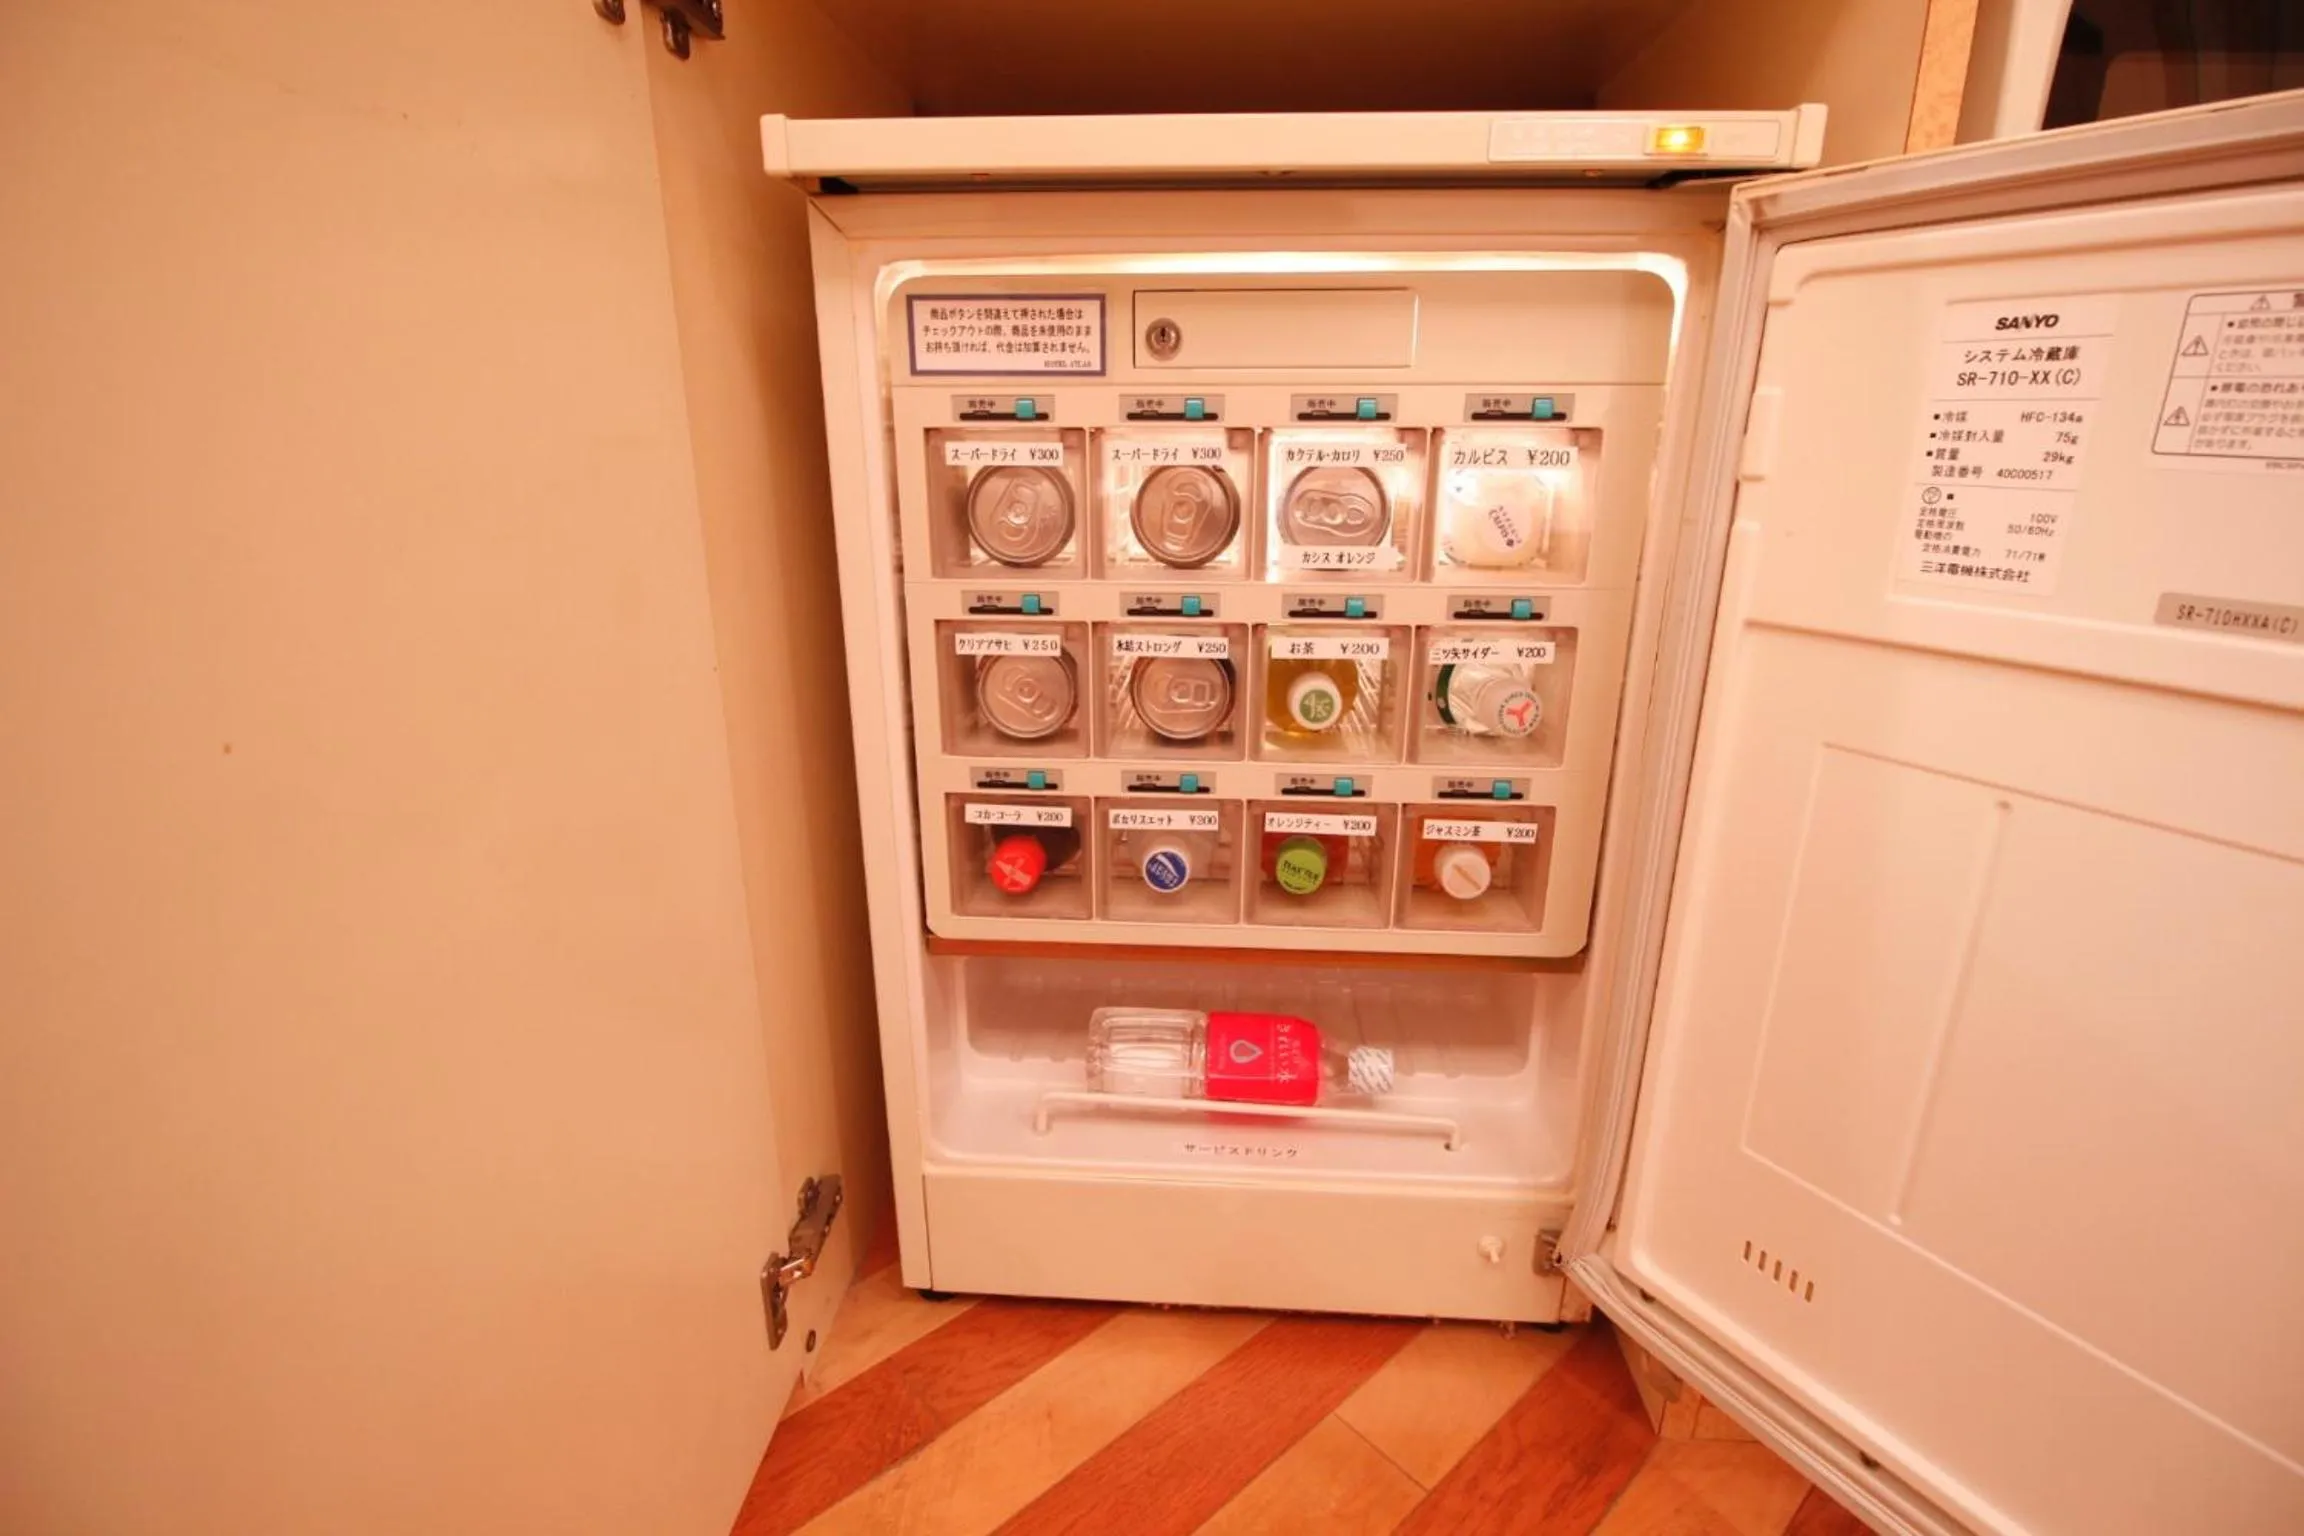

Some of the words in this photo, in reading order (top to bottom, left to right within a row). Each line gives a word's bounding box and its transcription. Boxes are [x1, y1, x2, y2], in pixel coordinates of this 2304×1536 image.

[1995, 314, 2060, 330] SANYO
[1964, 345, 2081, 363] システム冷蔵庫
[2020, 411, 2084, 424] HFC-134a
[2055, 431, 2079, 445] 75g
[951, 448, 1017, 461] スーパードライ
[1029, 448, 1060, 461] ¥300
[1112, 447, 1179, 461] スーパードライ
[1191, 447, 1222, 460] ¥300
[1373, 449, 1405, 462] ¥250
[1527, 449, 1571, 466] ¥200
[2042, 451, 2076, 465] 29kg
[1301, 552, 1331, 564] カシス
[1335, 551, 1376, 564] オレンジ
[959, 638, 1013, 651] クリアアサヒ
[1023, 640, 1059, 652] ¥250
[1196, 643, 1227, 654] ¥250
[1289, 641, 1315, 656] お茶
[1339, 642, 1381, 656] ¥200
[1432, 646, 1500, 660] 三ツ矢サイダー
[1516, 646, 1547, 659] ¥200
[1267, 817, 1331, 830] オレンジティー
[1343, 819, 1372, 831] ¥200
[1425, 824, 1482, 838] ジャスミン茶
[1506, 826, 1536, 839] ¥200
[1184, 1143, 1299, 1158] サービスドリンク
